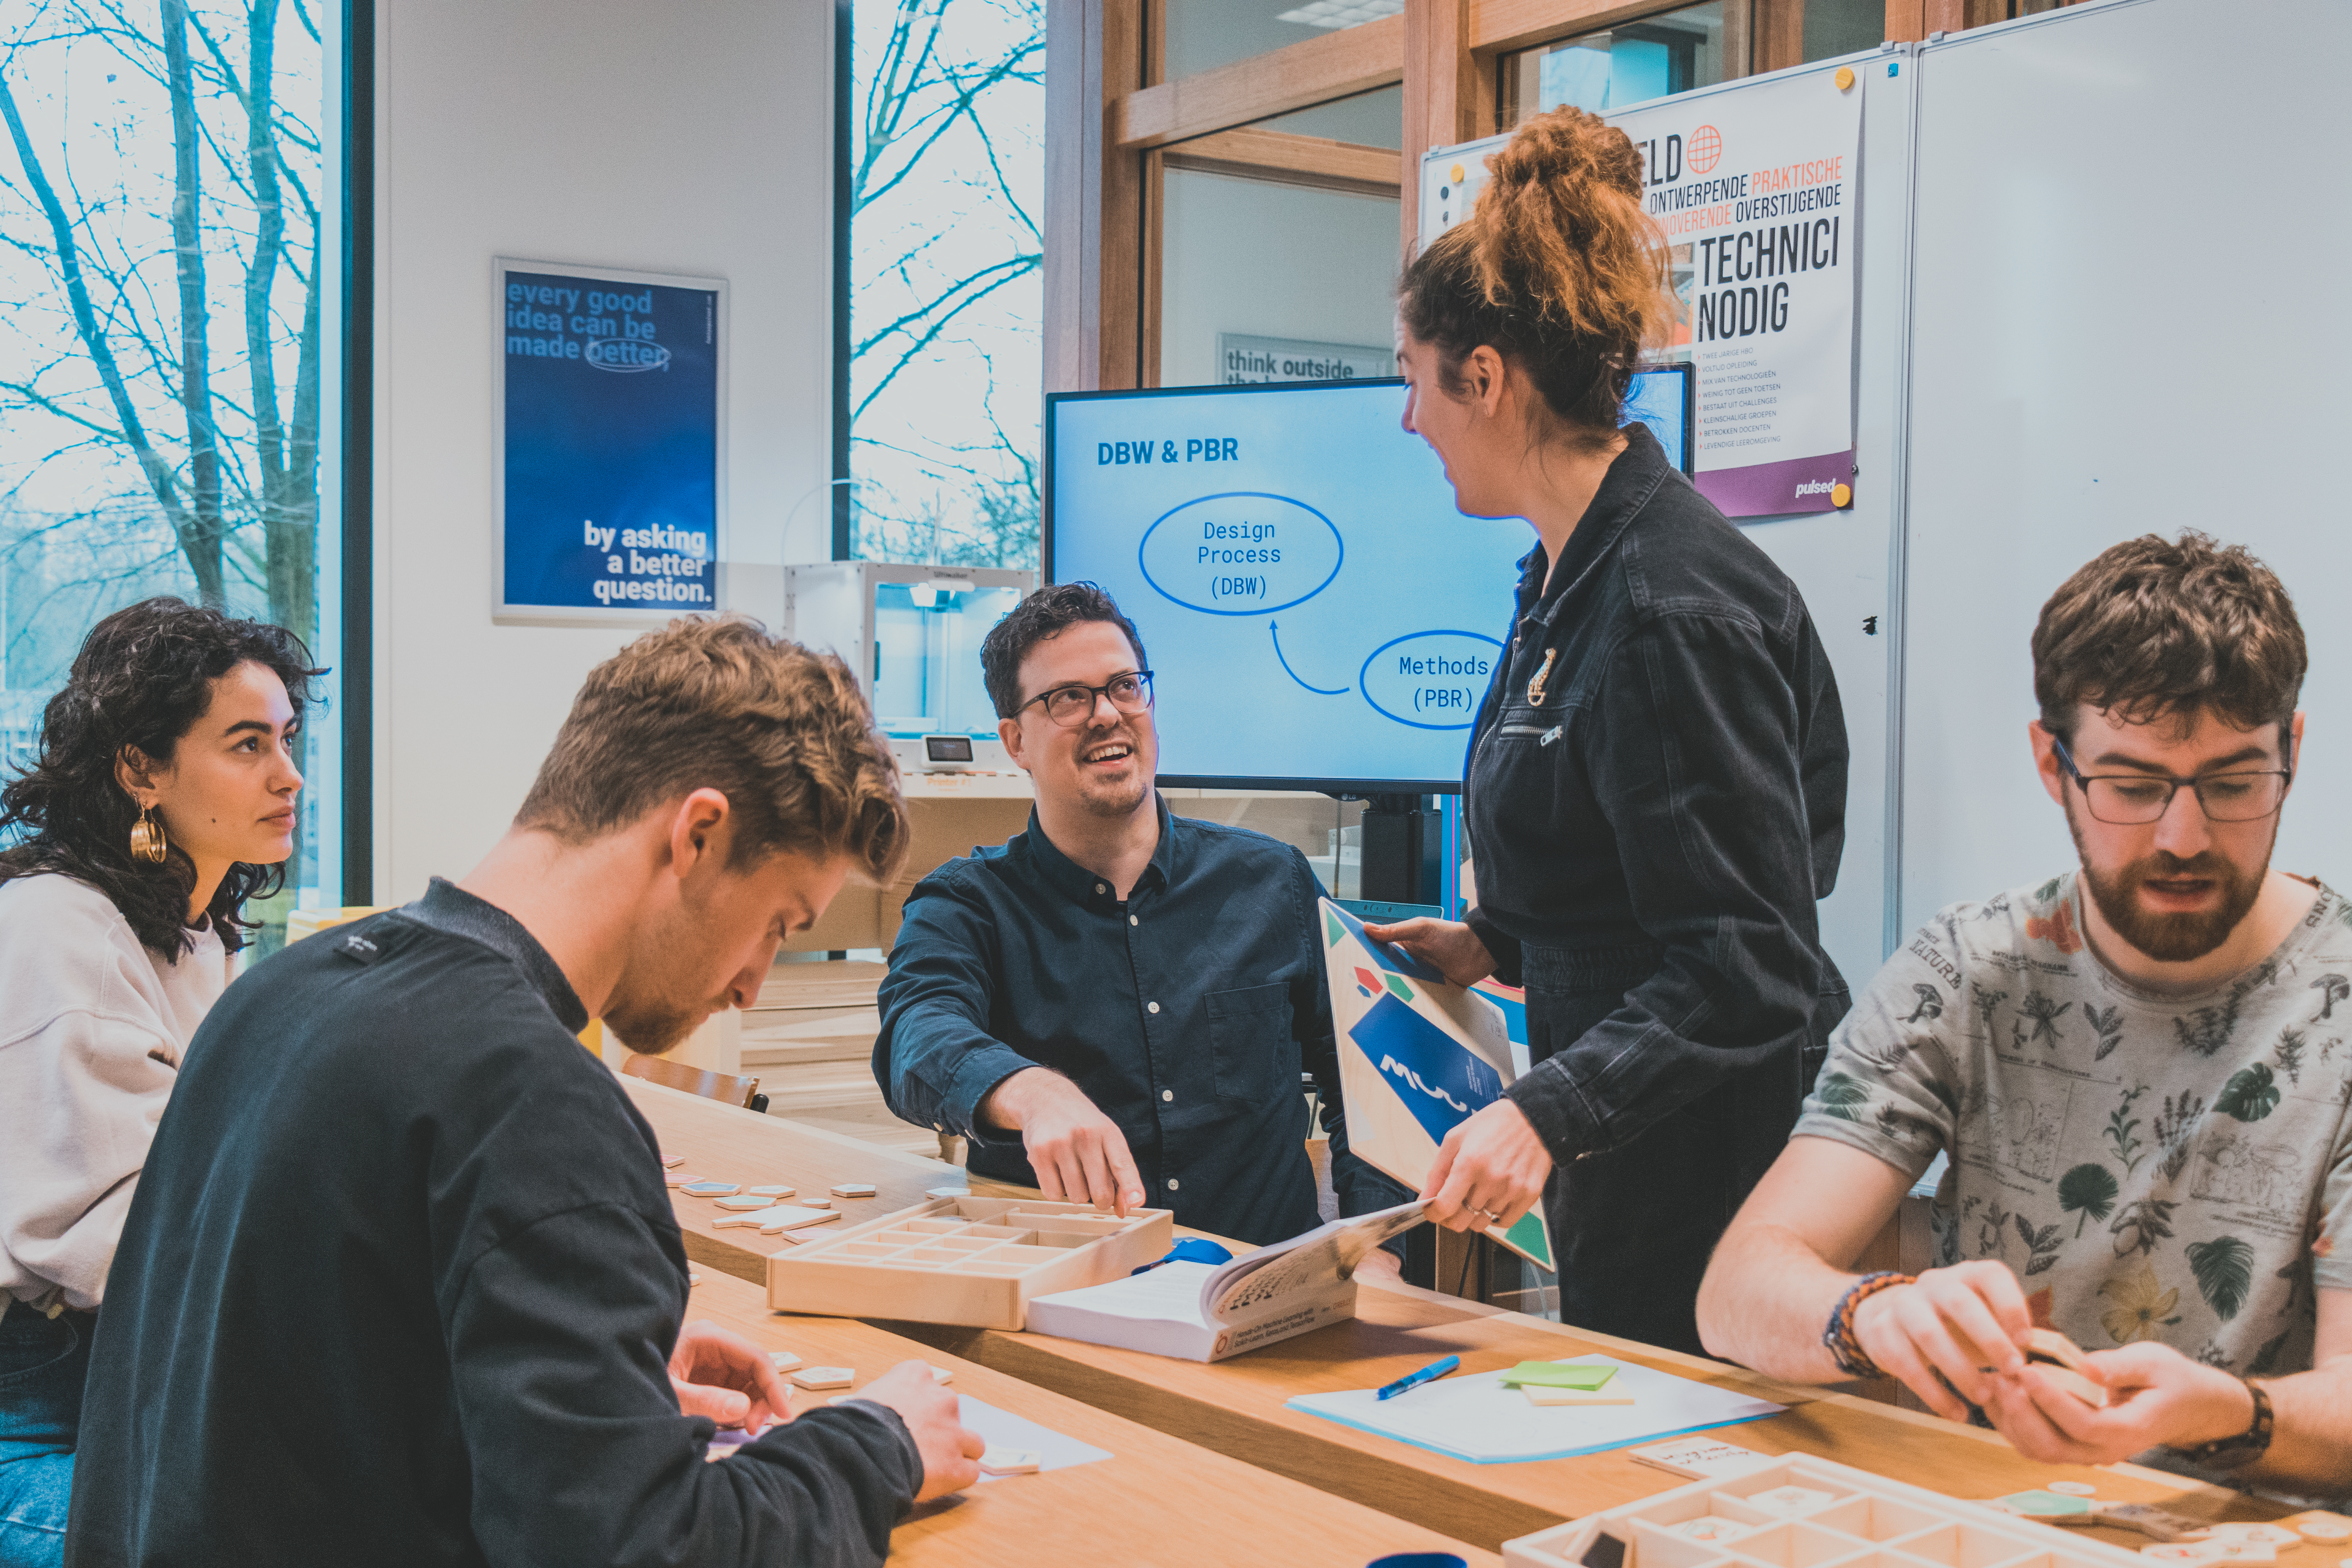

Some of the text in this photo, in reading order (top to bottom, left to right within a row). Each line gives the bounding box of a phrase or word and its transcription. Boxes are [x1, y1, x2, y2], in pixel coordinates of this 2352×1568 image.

[1650, 156, 1843, 214] ONTWERPENDE PRAKTISCHE
[1736, 184, 1841, 223] OVERSTIJGENDE
[1700, 216, 1839, 286] TECHNICI
[508, 283, 652, 315] every good
[508, 304, 656, 339] idea can be
[1698, 282, 1789, 342] NODIG
[507, 334, 580, 359] made
[1719, 349, 1739, 358] JARIGE
[1228, 350, 1277, 374] think
[1283, 359, 1354, 379] outside
[1702, 360, 1757, 372] VOLTIJD OPLEIDING
[1727, 370, 1776, 382] TECHNOLOGIEËN
[1754, 383, 1780, 392] TOETSEN
[1703, 403, 1726, 411] BESTAAT
[1739, 397, 1777, 407] CHALLENGES
[1704, 410, 1776, 424] KLEINSCHALIGE GROEPEN
[1704, 424, 1771, 437] BETROKKEN DOCENTEN
[1704, 436, 1781, 449] LEVENDIGE LEEROMGEVING
[1098, 438, 1238, 465] DBW & PBR
[1795, 478, 1836, 498] pulsed
[584, 520, 706, 557] by asking
[1205, 521, 1274, 543] Design
[608, 549, 706, 577] a better
[1199, 546, 1280, 563] Process
[593, 577, 712, 605] question.
[1212, 575, 1265, 600] (DBW)
[1400, 656, 1488, 675] Methods
[1414, 688, 1472, 712] (PBR)
[1909, 939, 1962, 989] NATURE
